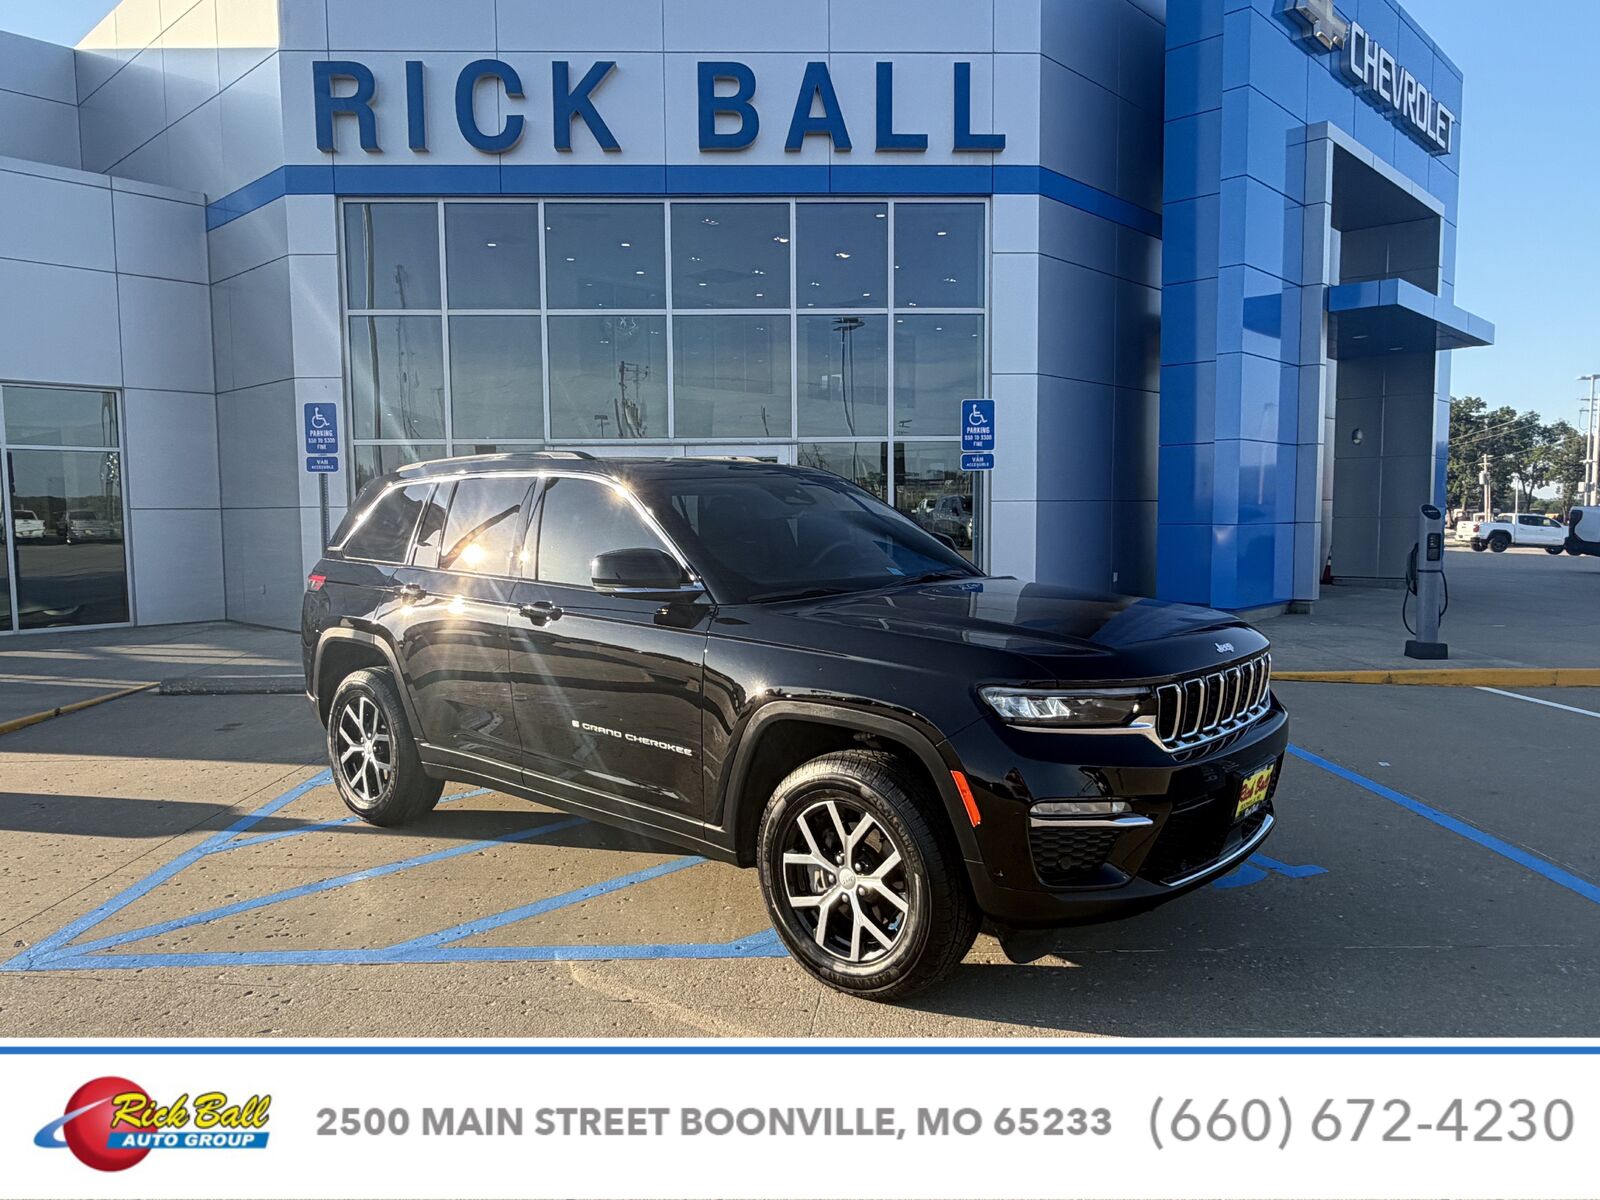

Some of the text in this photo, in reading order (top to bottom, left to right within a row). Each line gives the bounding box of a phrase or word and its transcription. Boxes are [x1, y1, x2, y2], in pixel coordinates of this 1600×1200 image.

[311, 59, 1007, 153] RICK BALL
[1350, 20, 1456, 154] CHEVROLET
[1214, 642, 1235, 653] Jeep
[581, 722, 692, 756] GRAND CHEROKEE
